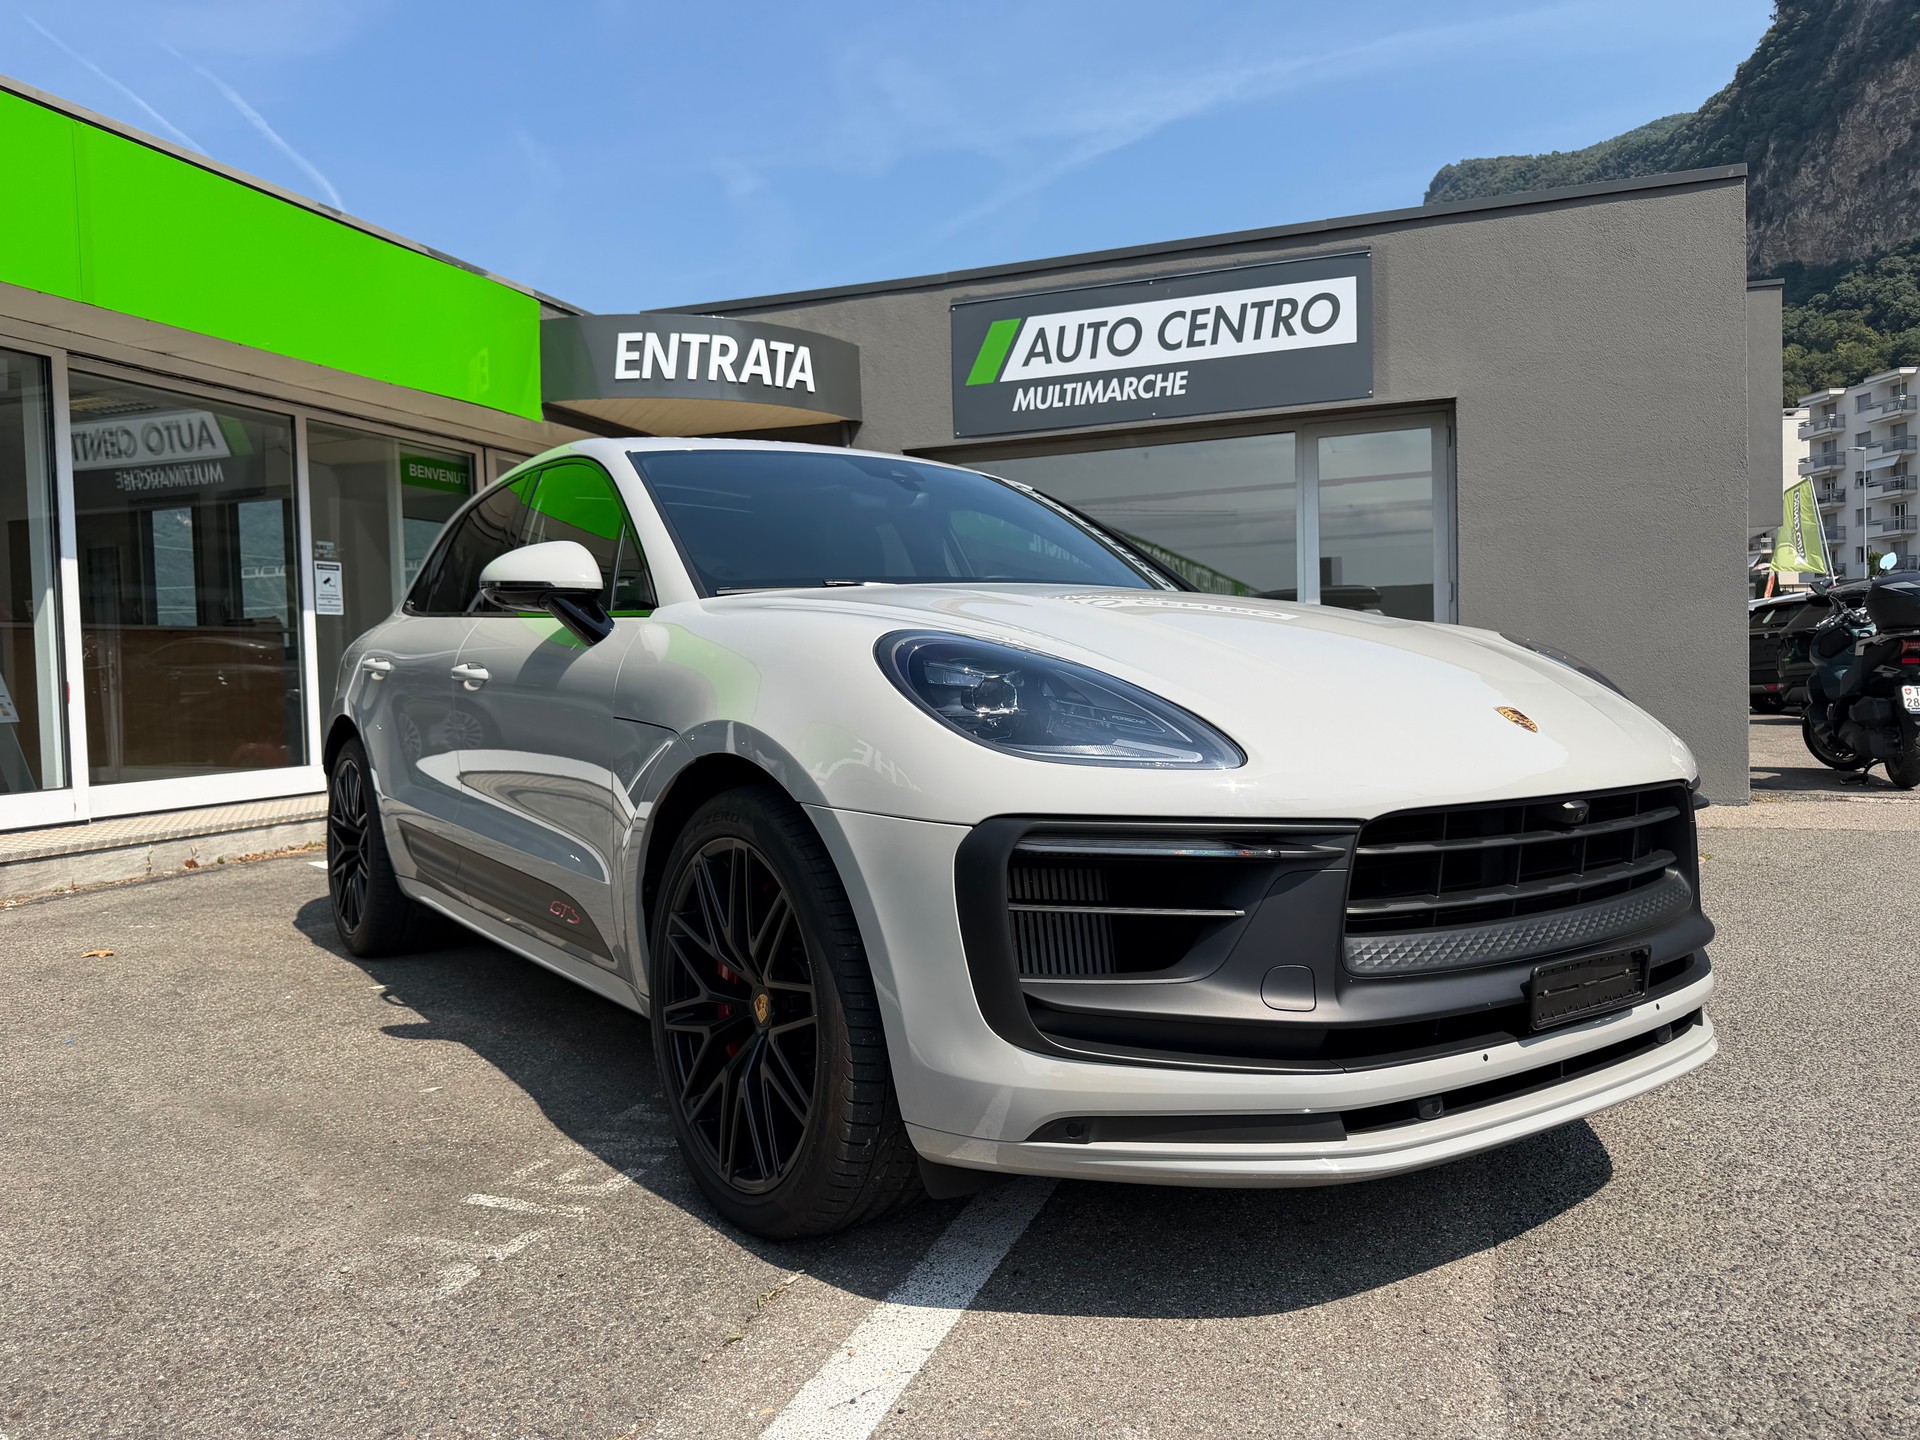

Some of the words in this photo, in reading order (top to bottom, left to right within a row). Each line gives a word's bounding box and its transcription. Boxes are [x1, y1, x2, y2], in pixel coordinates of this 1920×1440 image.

[1021, 316, 1143, 368] AUTO
[1157, 292, 1341, 352] CENTRO
[614, 332, 816, 393] ENTRATA
[1012, 370, 1189, 412] MULTIMARCHE
[408, 463, 469, 486] BENVENUT
[1906, 697, 1920, 708] 28
[550, 900, 581, 925] GTS
